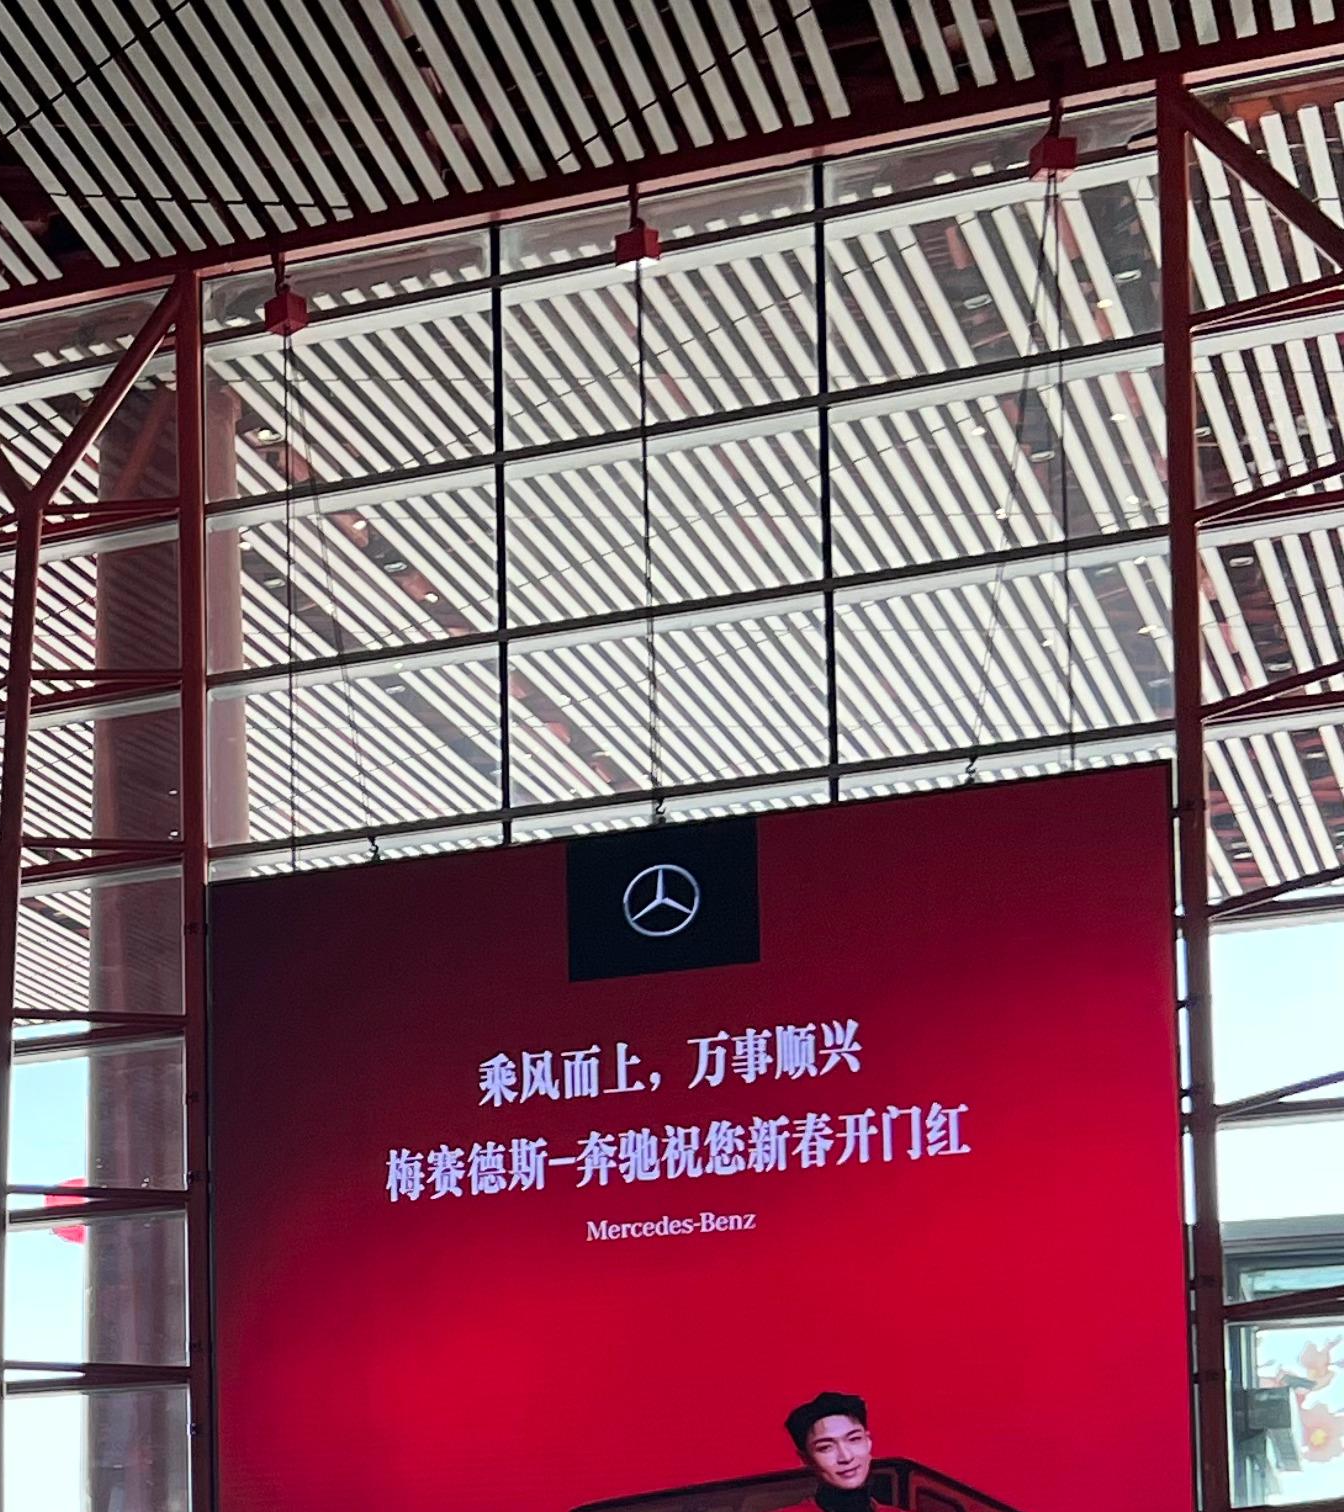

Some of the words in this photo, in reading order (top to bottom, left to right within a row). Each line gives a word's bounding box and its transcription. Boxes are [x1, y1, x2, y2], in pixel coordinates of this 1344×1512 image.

[478, 1018, 862, 1108] 乘风而上，万事顺兴
[586, 1209, 757, 1243] Mercedes-Benz
